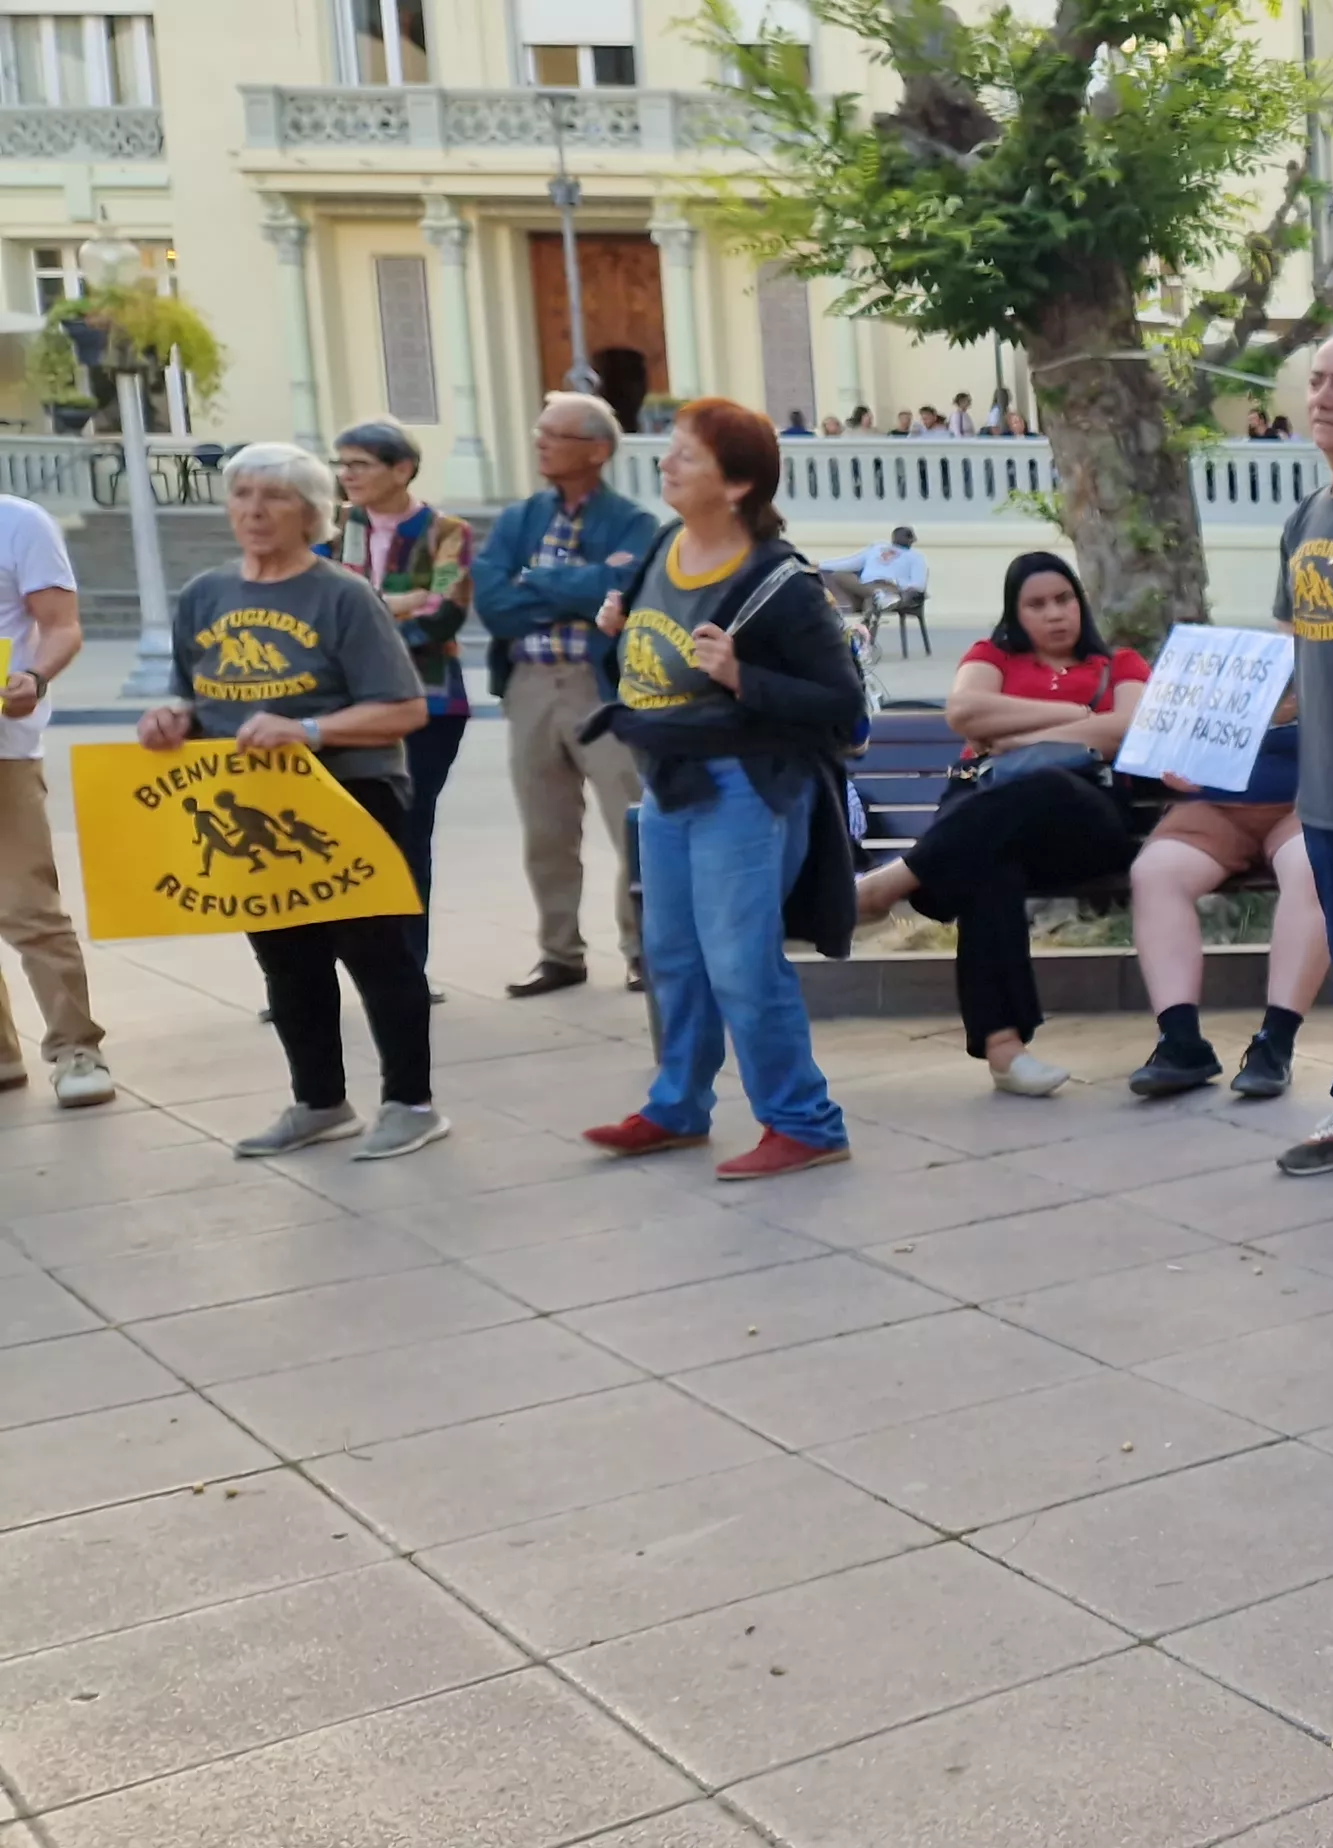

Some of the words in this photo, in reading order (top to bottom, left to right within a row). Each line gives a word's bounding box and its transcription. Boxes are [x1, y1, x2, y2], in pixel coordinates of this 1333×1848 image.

[1189, 716, 1253, 750] RACISMO
[133, 751, 313, 810] BIENVENID
[154, 857, 376, 917] REFUGIADXS
